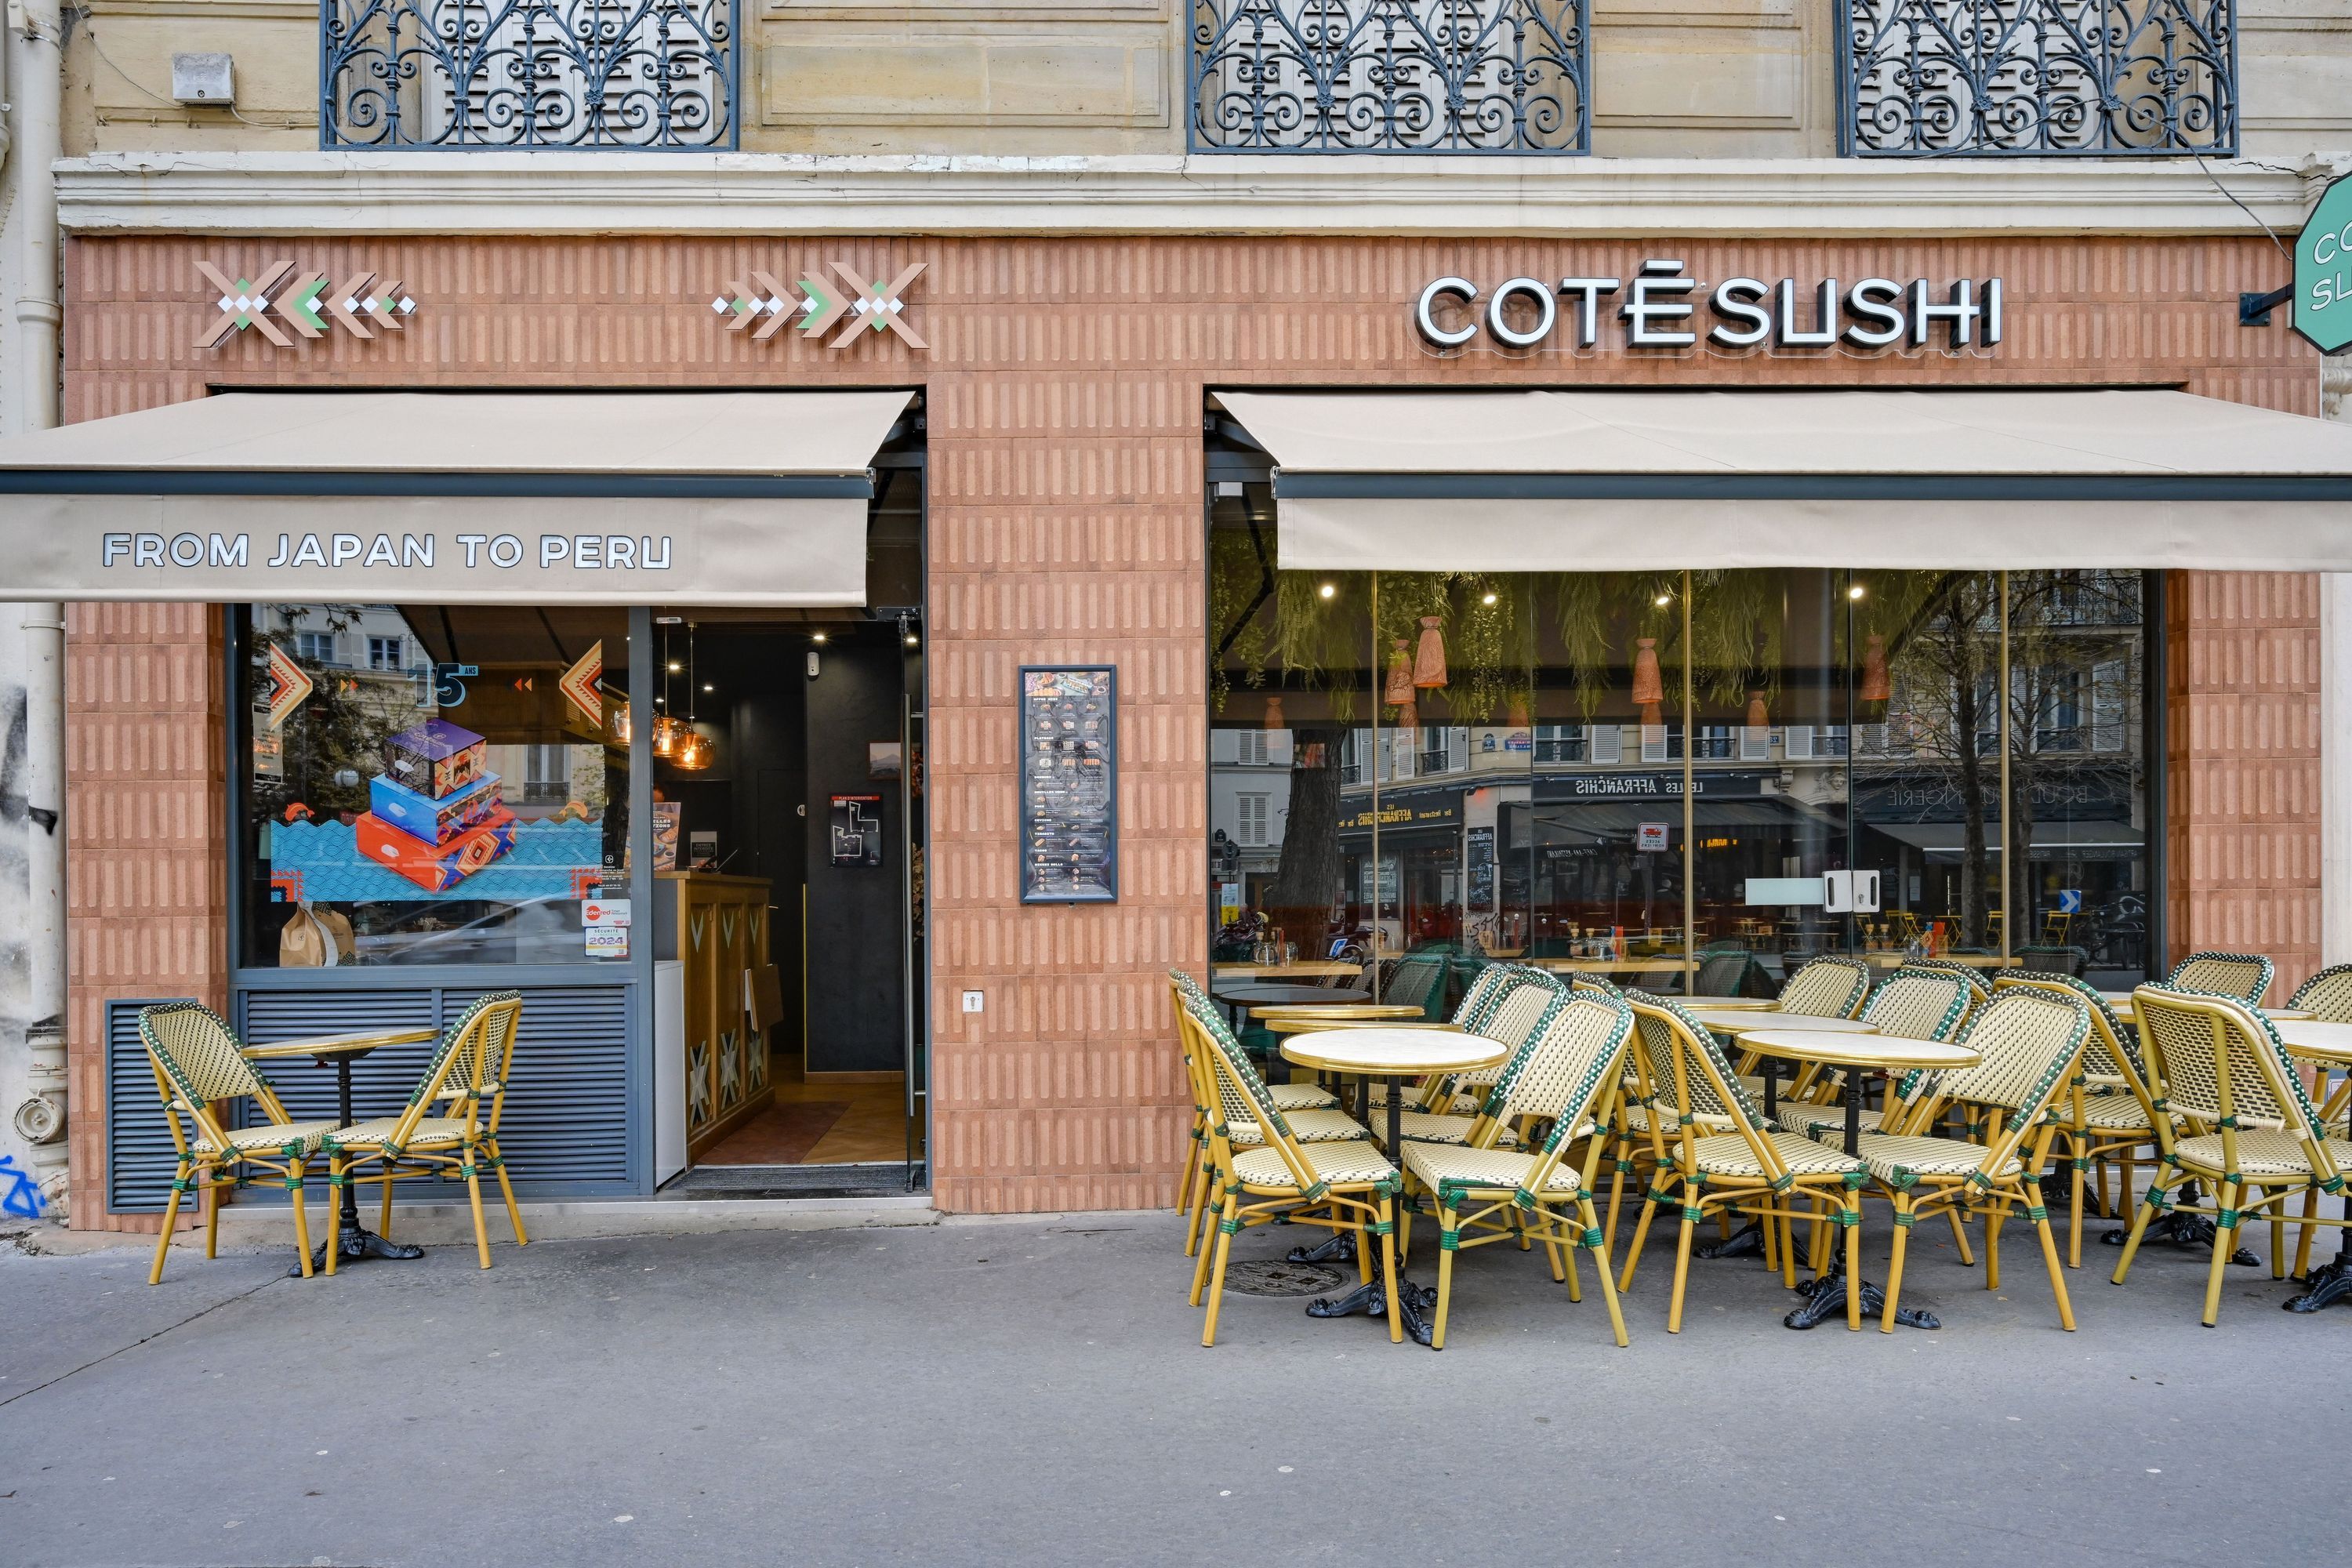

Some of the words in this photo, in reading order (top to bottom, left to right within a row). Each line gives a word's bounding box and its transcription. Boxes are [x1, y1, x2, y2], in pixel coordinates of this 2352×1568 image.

[1708, 276, 2002, 350] SUSHI
[103, 533, 249, 568] FROM
[267, 533, 434, 568] JAPAN
[456, 535, 524, 568] TO
[539, 535, 672, 570] PERU
[406, 660, 466, 708] 15
[464, 666, 477, 675] ANS
[589, 936, 624, 946] 2024
